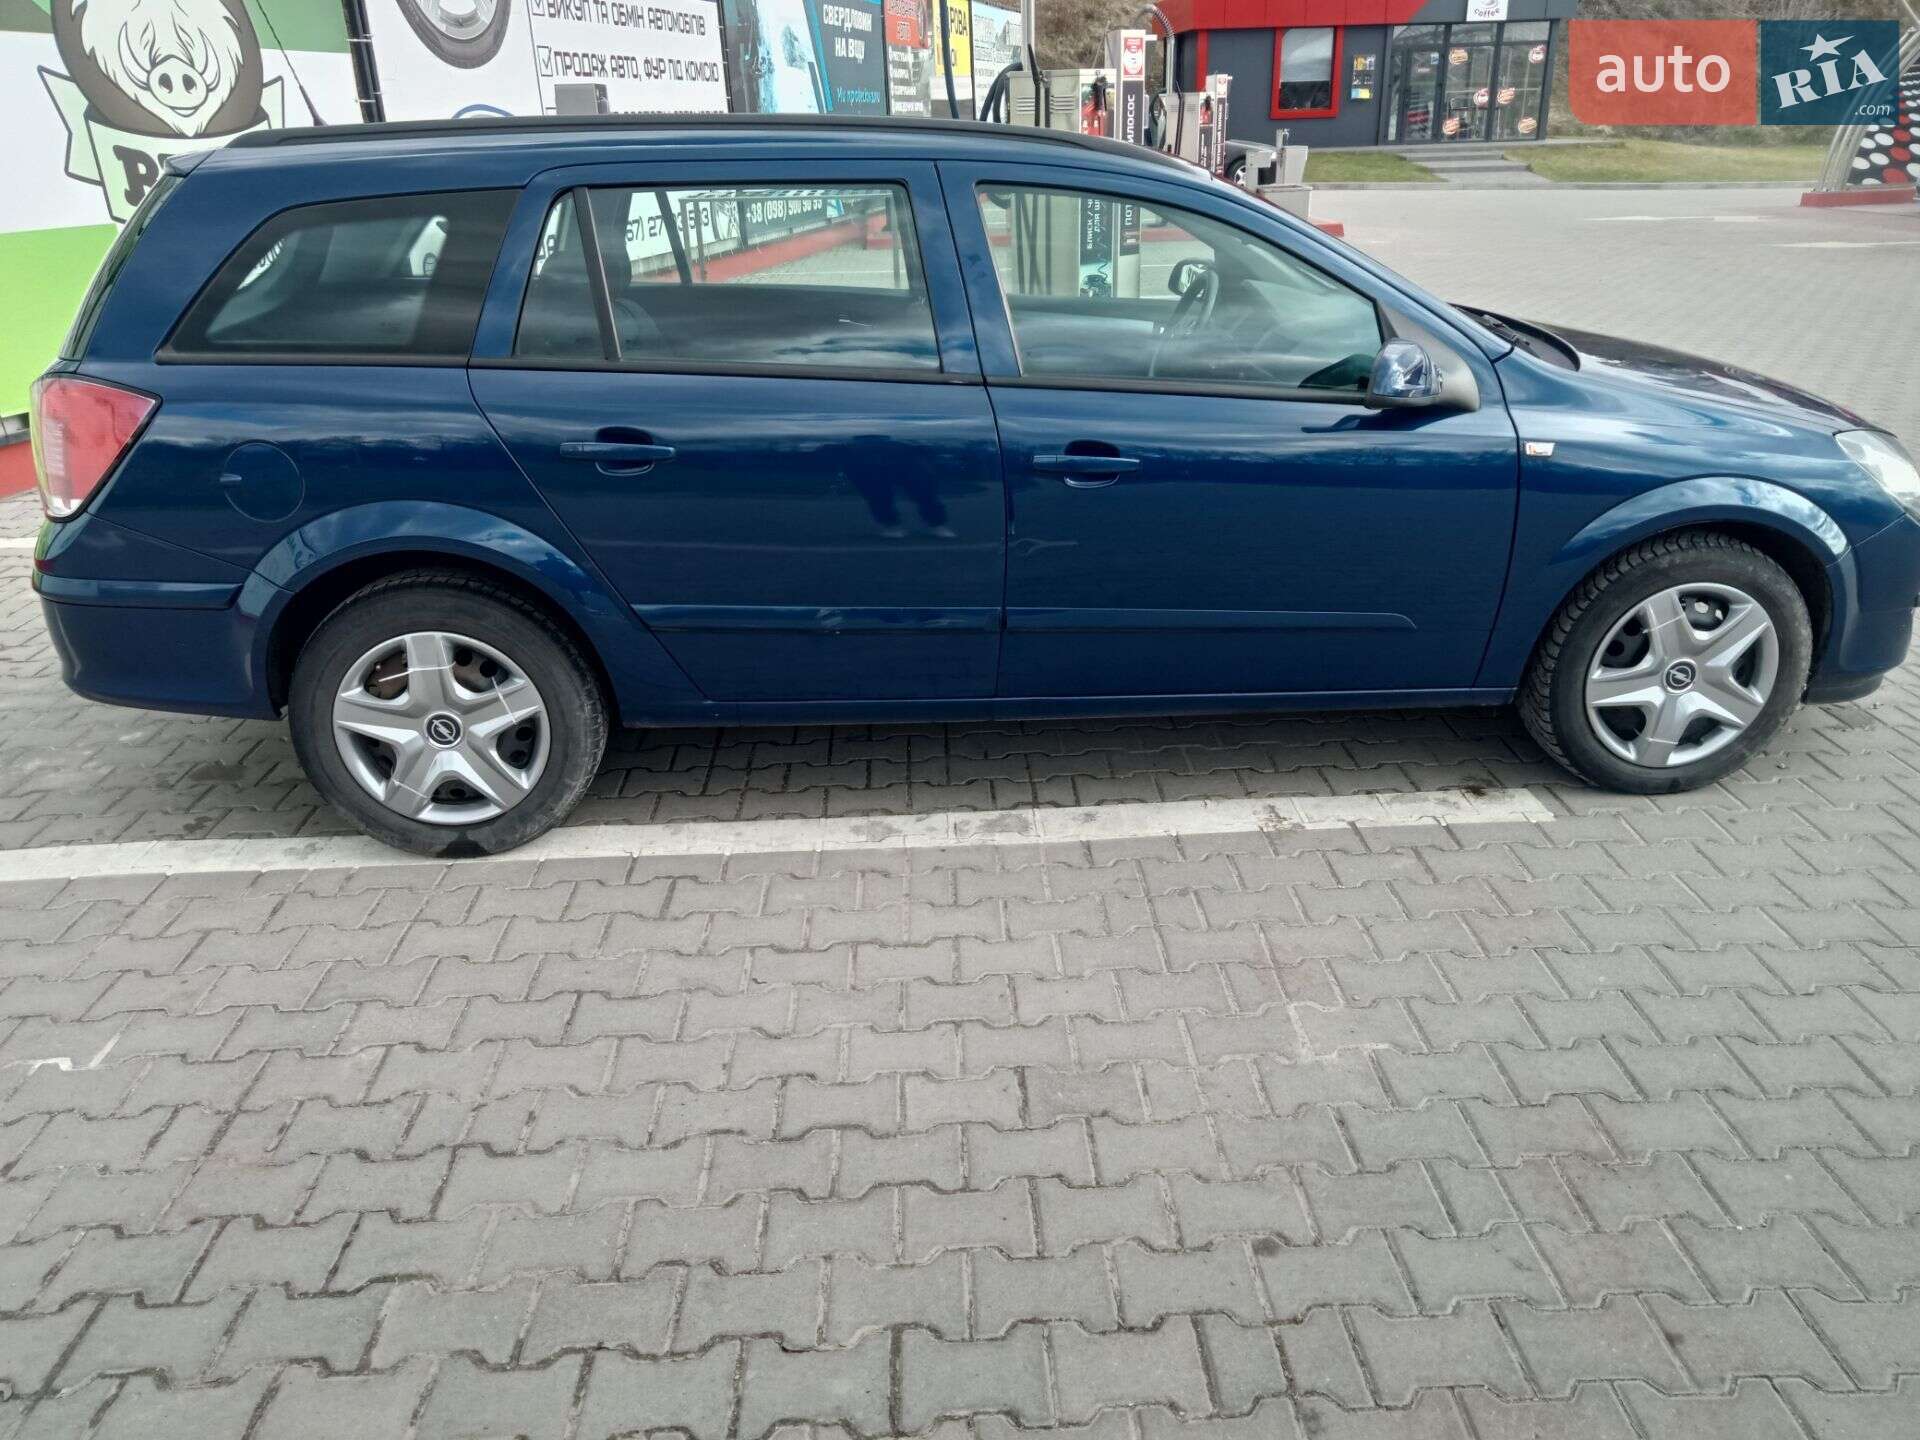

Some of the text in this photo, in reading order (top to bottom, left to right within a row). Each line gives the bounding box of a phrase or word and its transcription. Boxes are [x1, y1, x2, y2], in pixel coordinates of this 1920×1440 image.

[593, 0, 610, 24] ТА
[611, 2, 644, 28] ОБМІН
[950, 6, 968, 36] РОВА
[835, 37, 847, 58] НА
[554, 51, 608, 78] ПРОДАЖ
[610, 54, 642, 82] АВТО,
[644, 56, 666, 80] ФУР
[1126, 94, 1135, 144] ИЛОСОС
